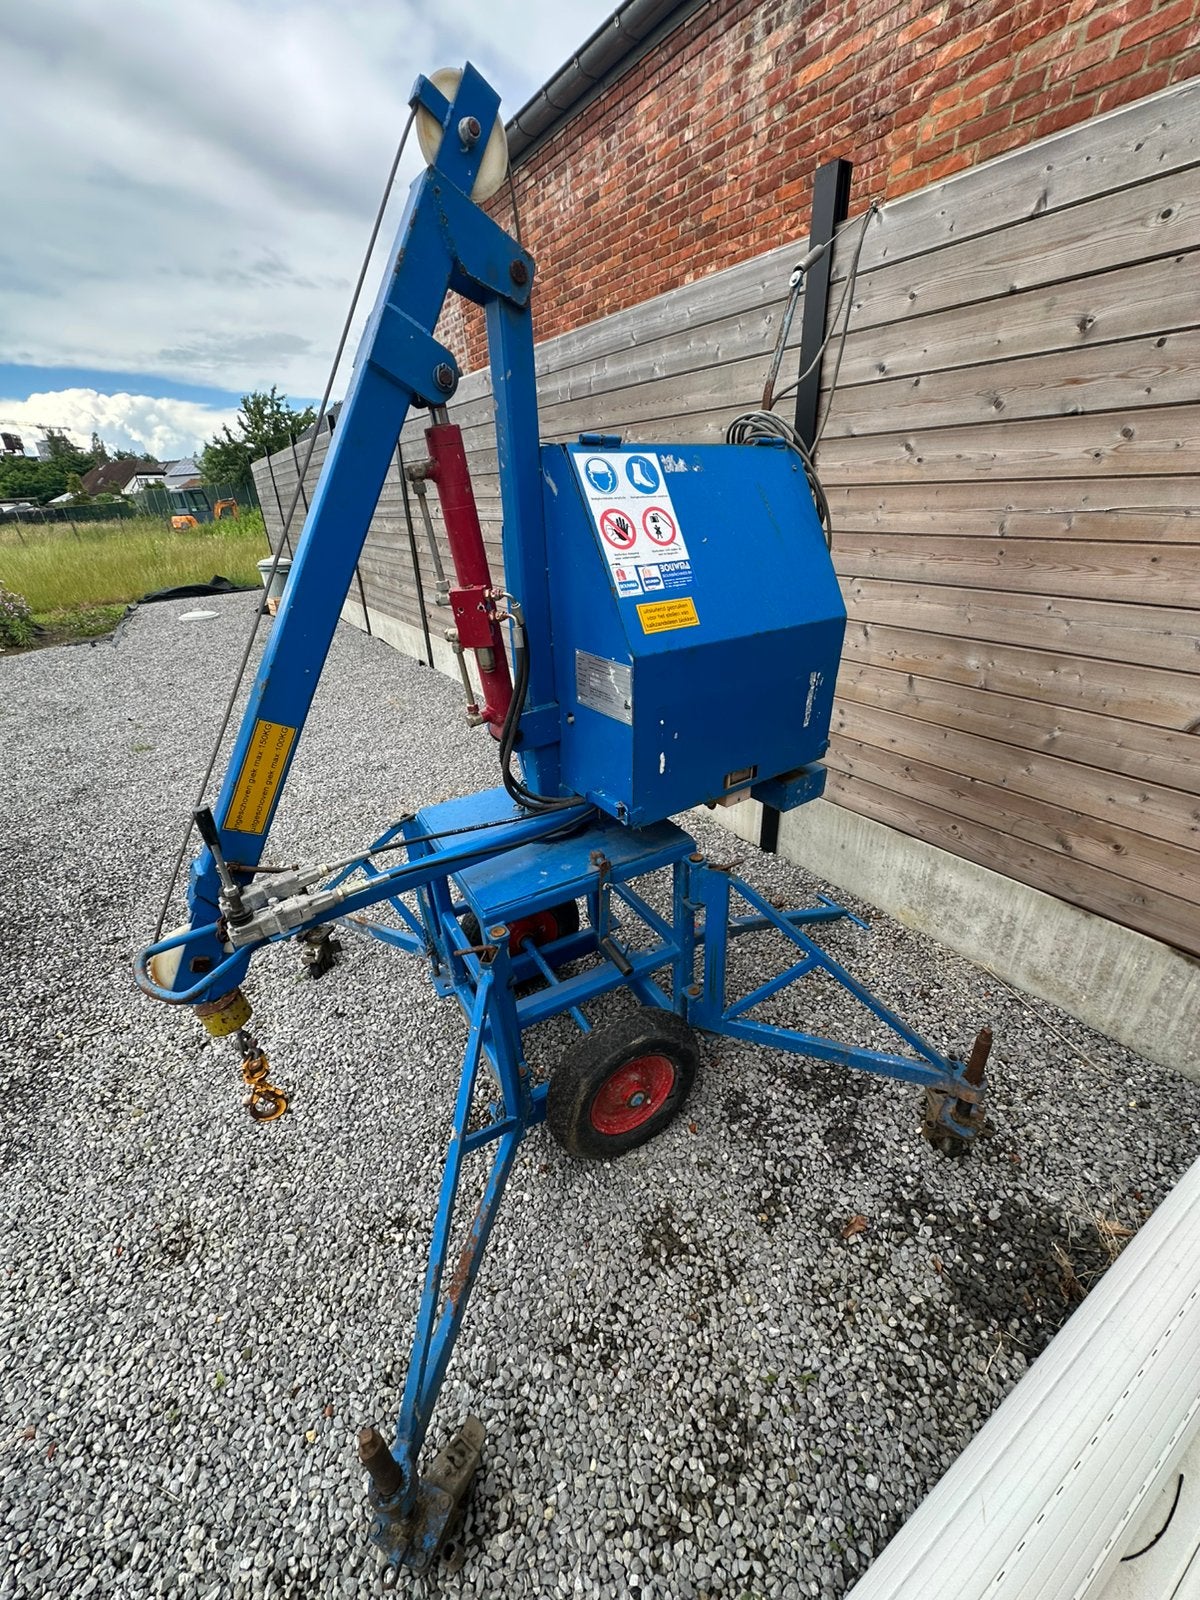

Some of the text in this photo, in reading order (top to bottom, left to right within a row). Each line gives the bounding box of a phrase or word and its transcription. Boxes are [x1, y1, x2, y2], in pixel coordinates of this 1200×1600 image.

[249, 768, 258, 784] giek
[254, 752, 263, 768] max
[259, 724, 272, 748] 150KG
[250, 727, 289, 832] uitgeschoven giek max 100KG
